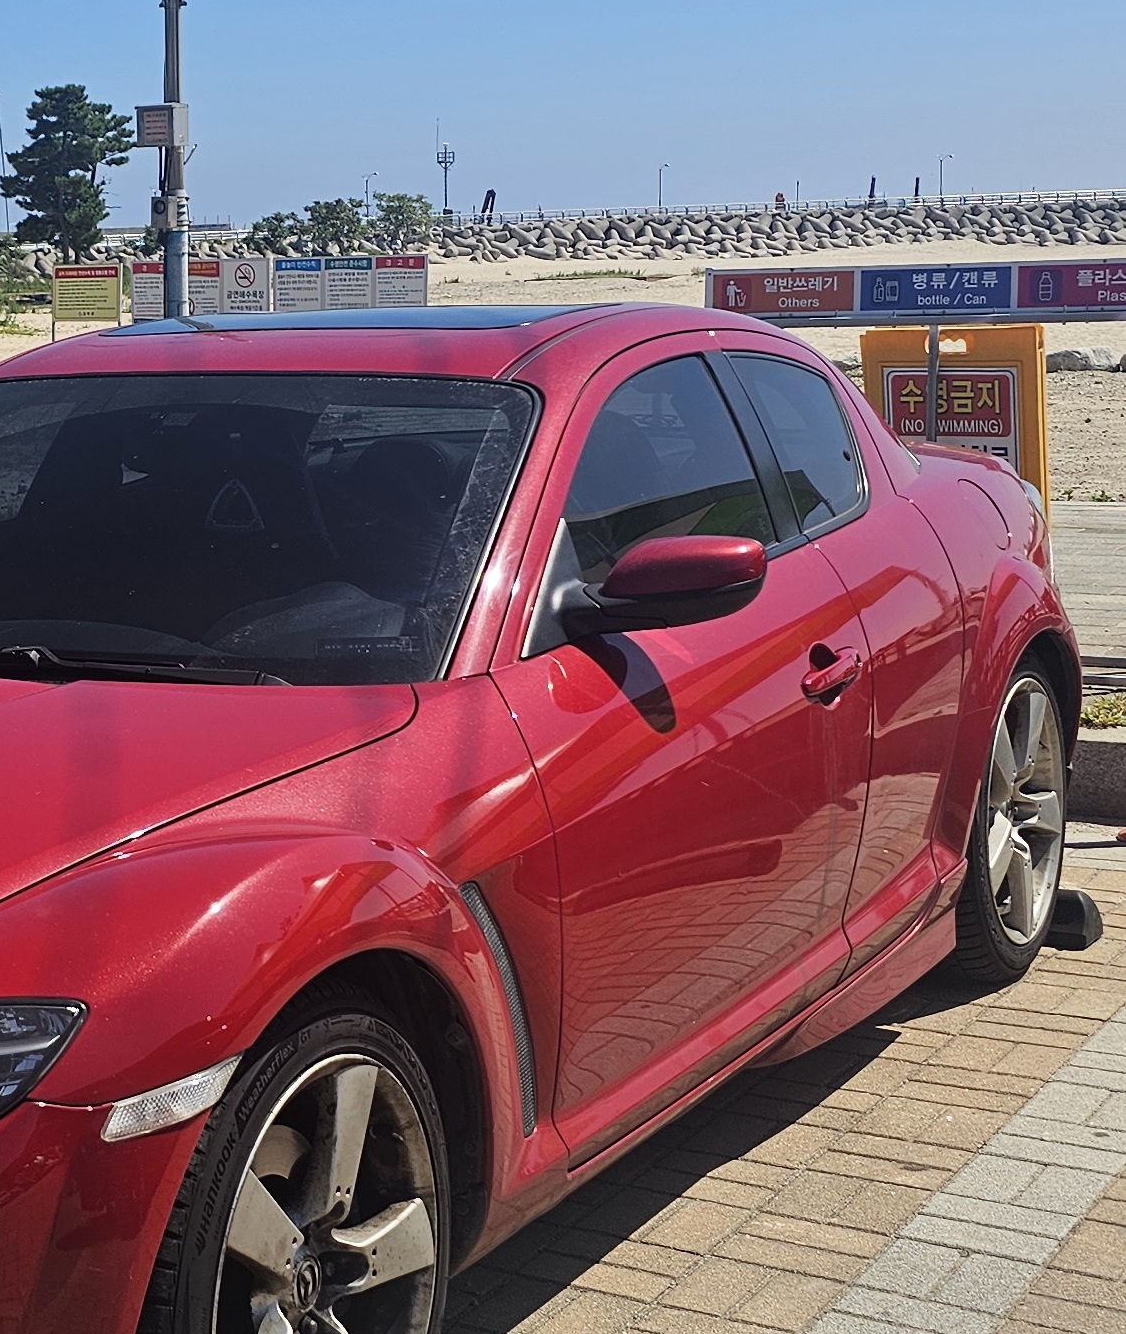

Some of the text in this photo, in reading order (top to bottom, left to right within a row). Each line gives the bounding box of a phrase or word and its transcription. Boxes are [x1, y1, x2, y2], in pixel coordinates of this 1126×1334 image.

[764, 275, 838, 293] 일반쓰레기
[778, 297, 820, 308] Others
[917, 294, 951, 306] bottle
[964, 293, 987, 305] Can
[900, 418, 1003, 435] (NO WIMMING)
[238, 1041, 296, 1123] Weatherflex
